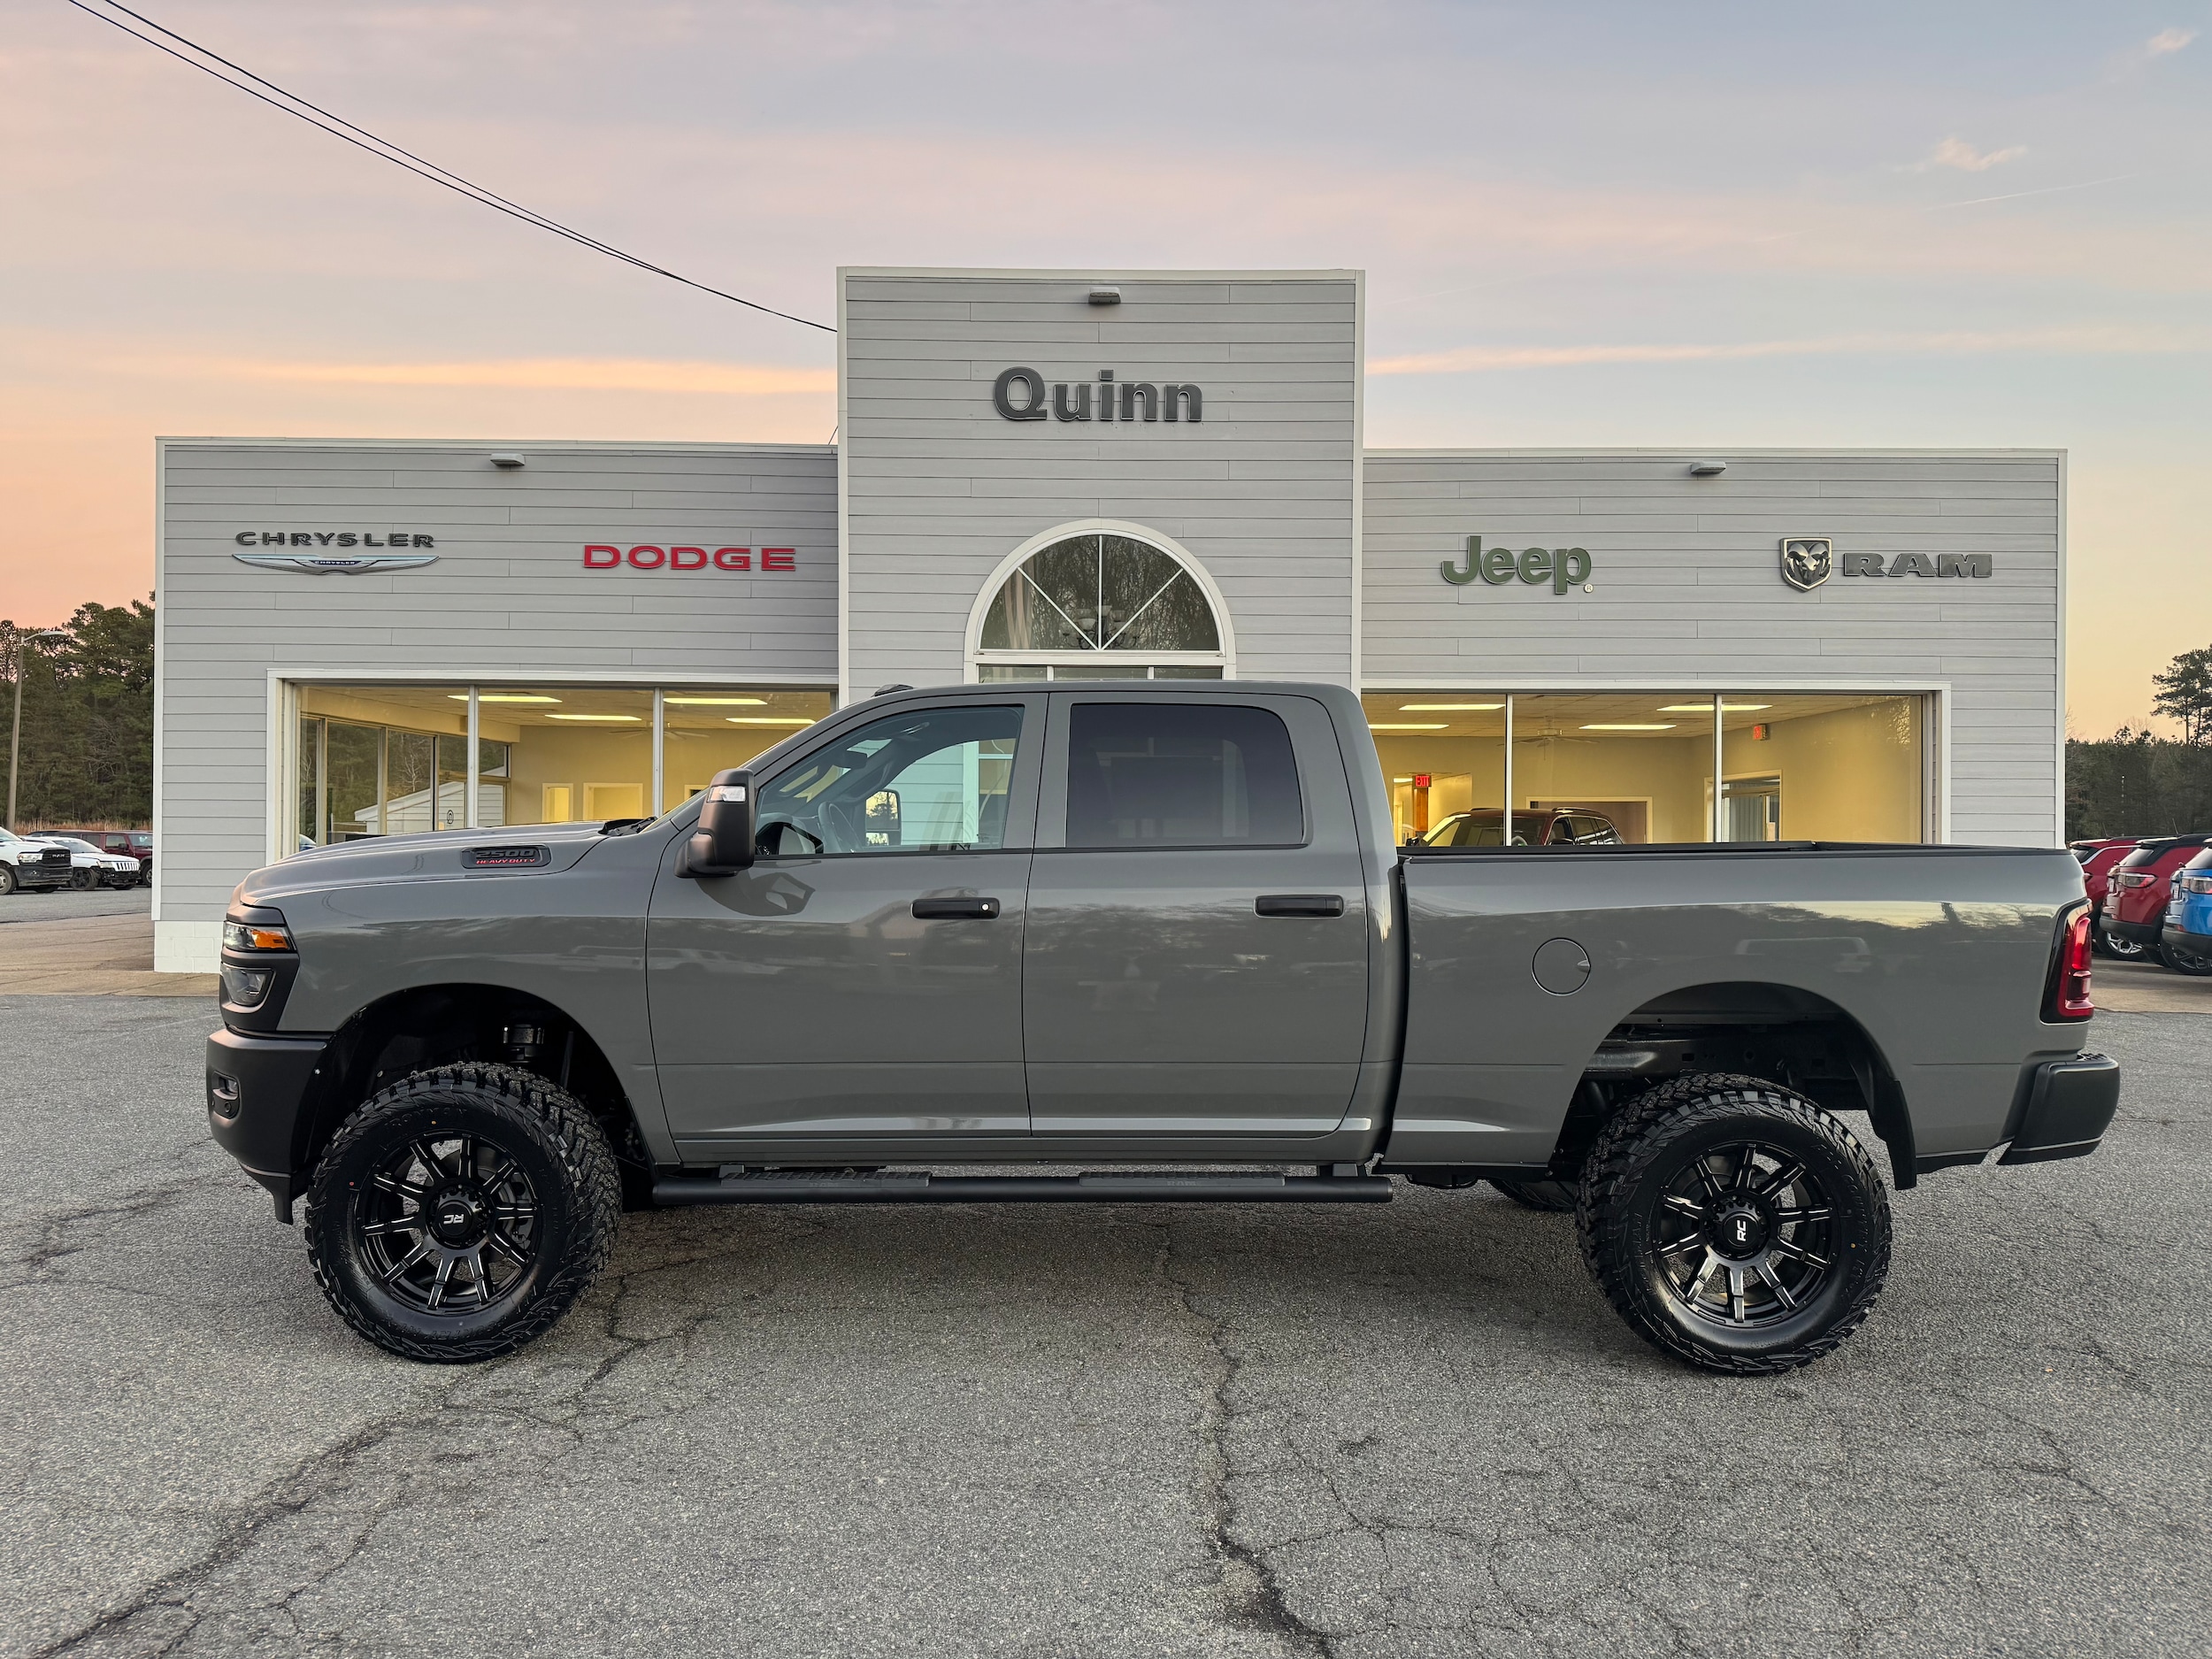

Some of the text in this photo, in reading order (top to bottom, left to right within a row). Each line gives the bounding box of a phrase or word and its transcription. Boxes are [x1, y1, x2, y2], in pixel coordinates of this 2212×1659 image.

[994, 365, 1203, 422] Quinn
[234, 531, 434, 548] CHRYSLER
[582, 544, 796, 572] DODGE
[1441, 535, 1593, 595] Jeep
[1843, 552, 1993, 579] RAM
[1416, 775, 1430, 787] EXIT
[476, 849, 535, 859] 2500
[443, 1214, 465, 1225] RC
[1737, 1220, 1747, 1242] RC
